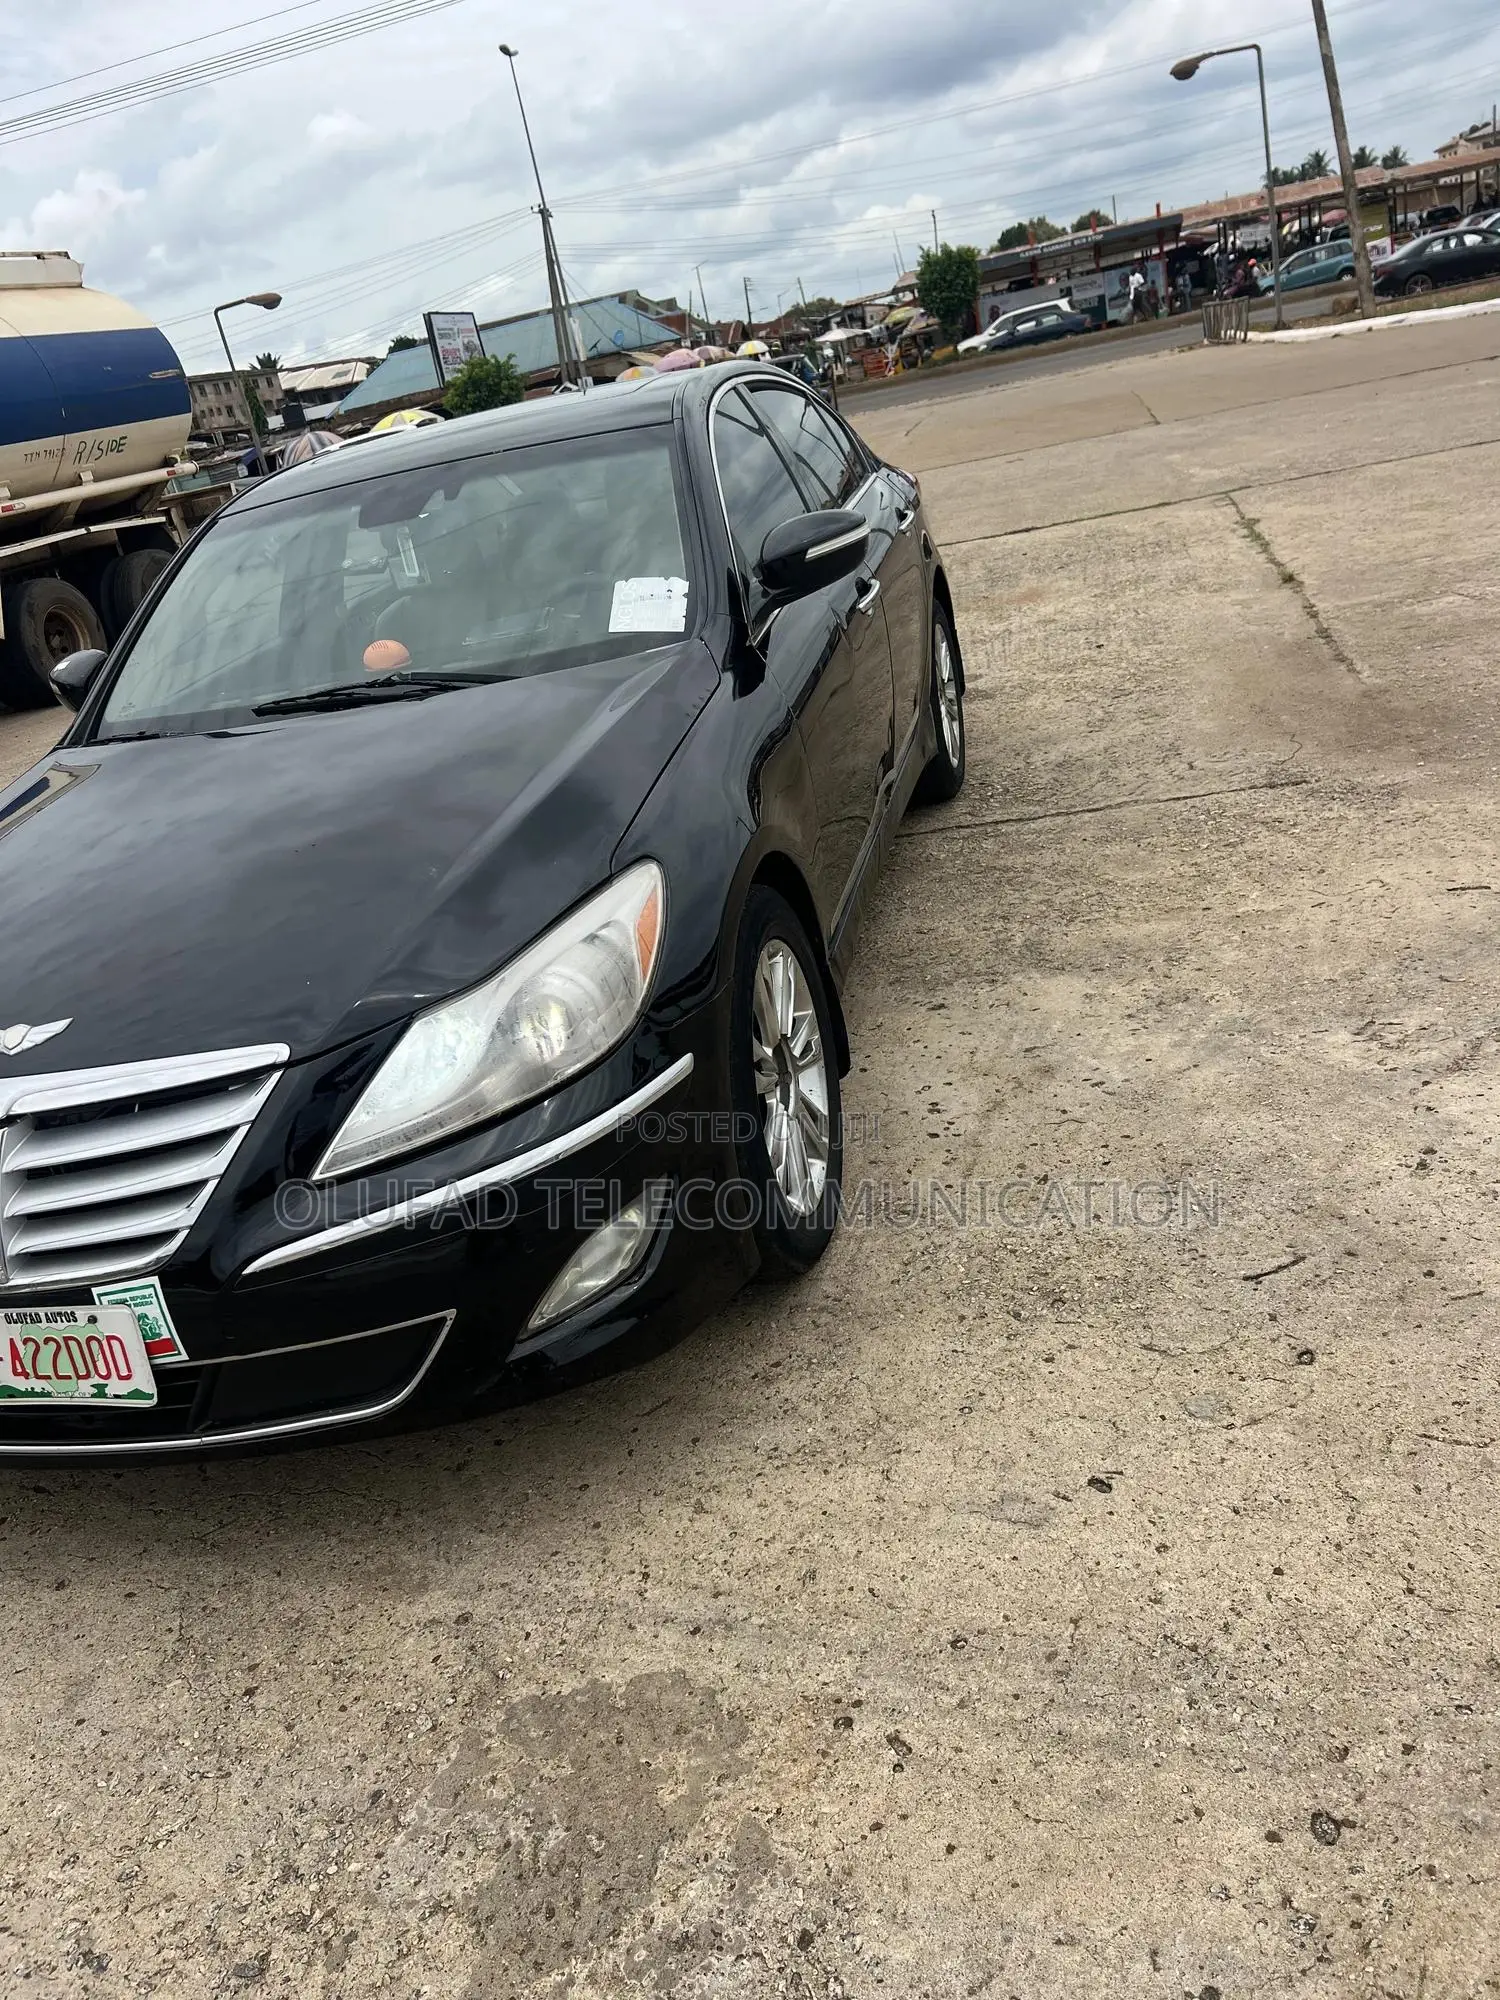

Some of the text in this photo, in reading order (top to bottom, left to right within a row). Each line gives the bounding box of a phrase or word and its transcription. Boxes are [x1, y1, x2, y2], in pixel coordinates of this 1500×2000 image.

[73, 436, 128, 465] R/SIDE
[129, 1293, 154, 1302] REPUBLIC
[132, 1300, 153, 1308] NIGERIA
[4, 1311, 78, 1325] OLUFAD AUTOS
